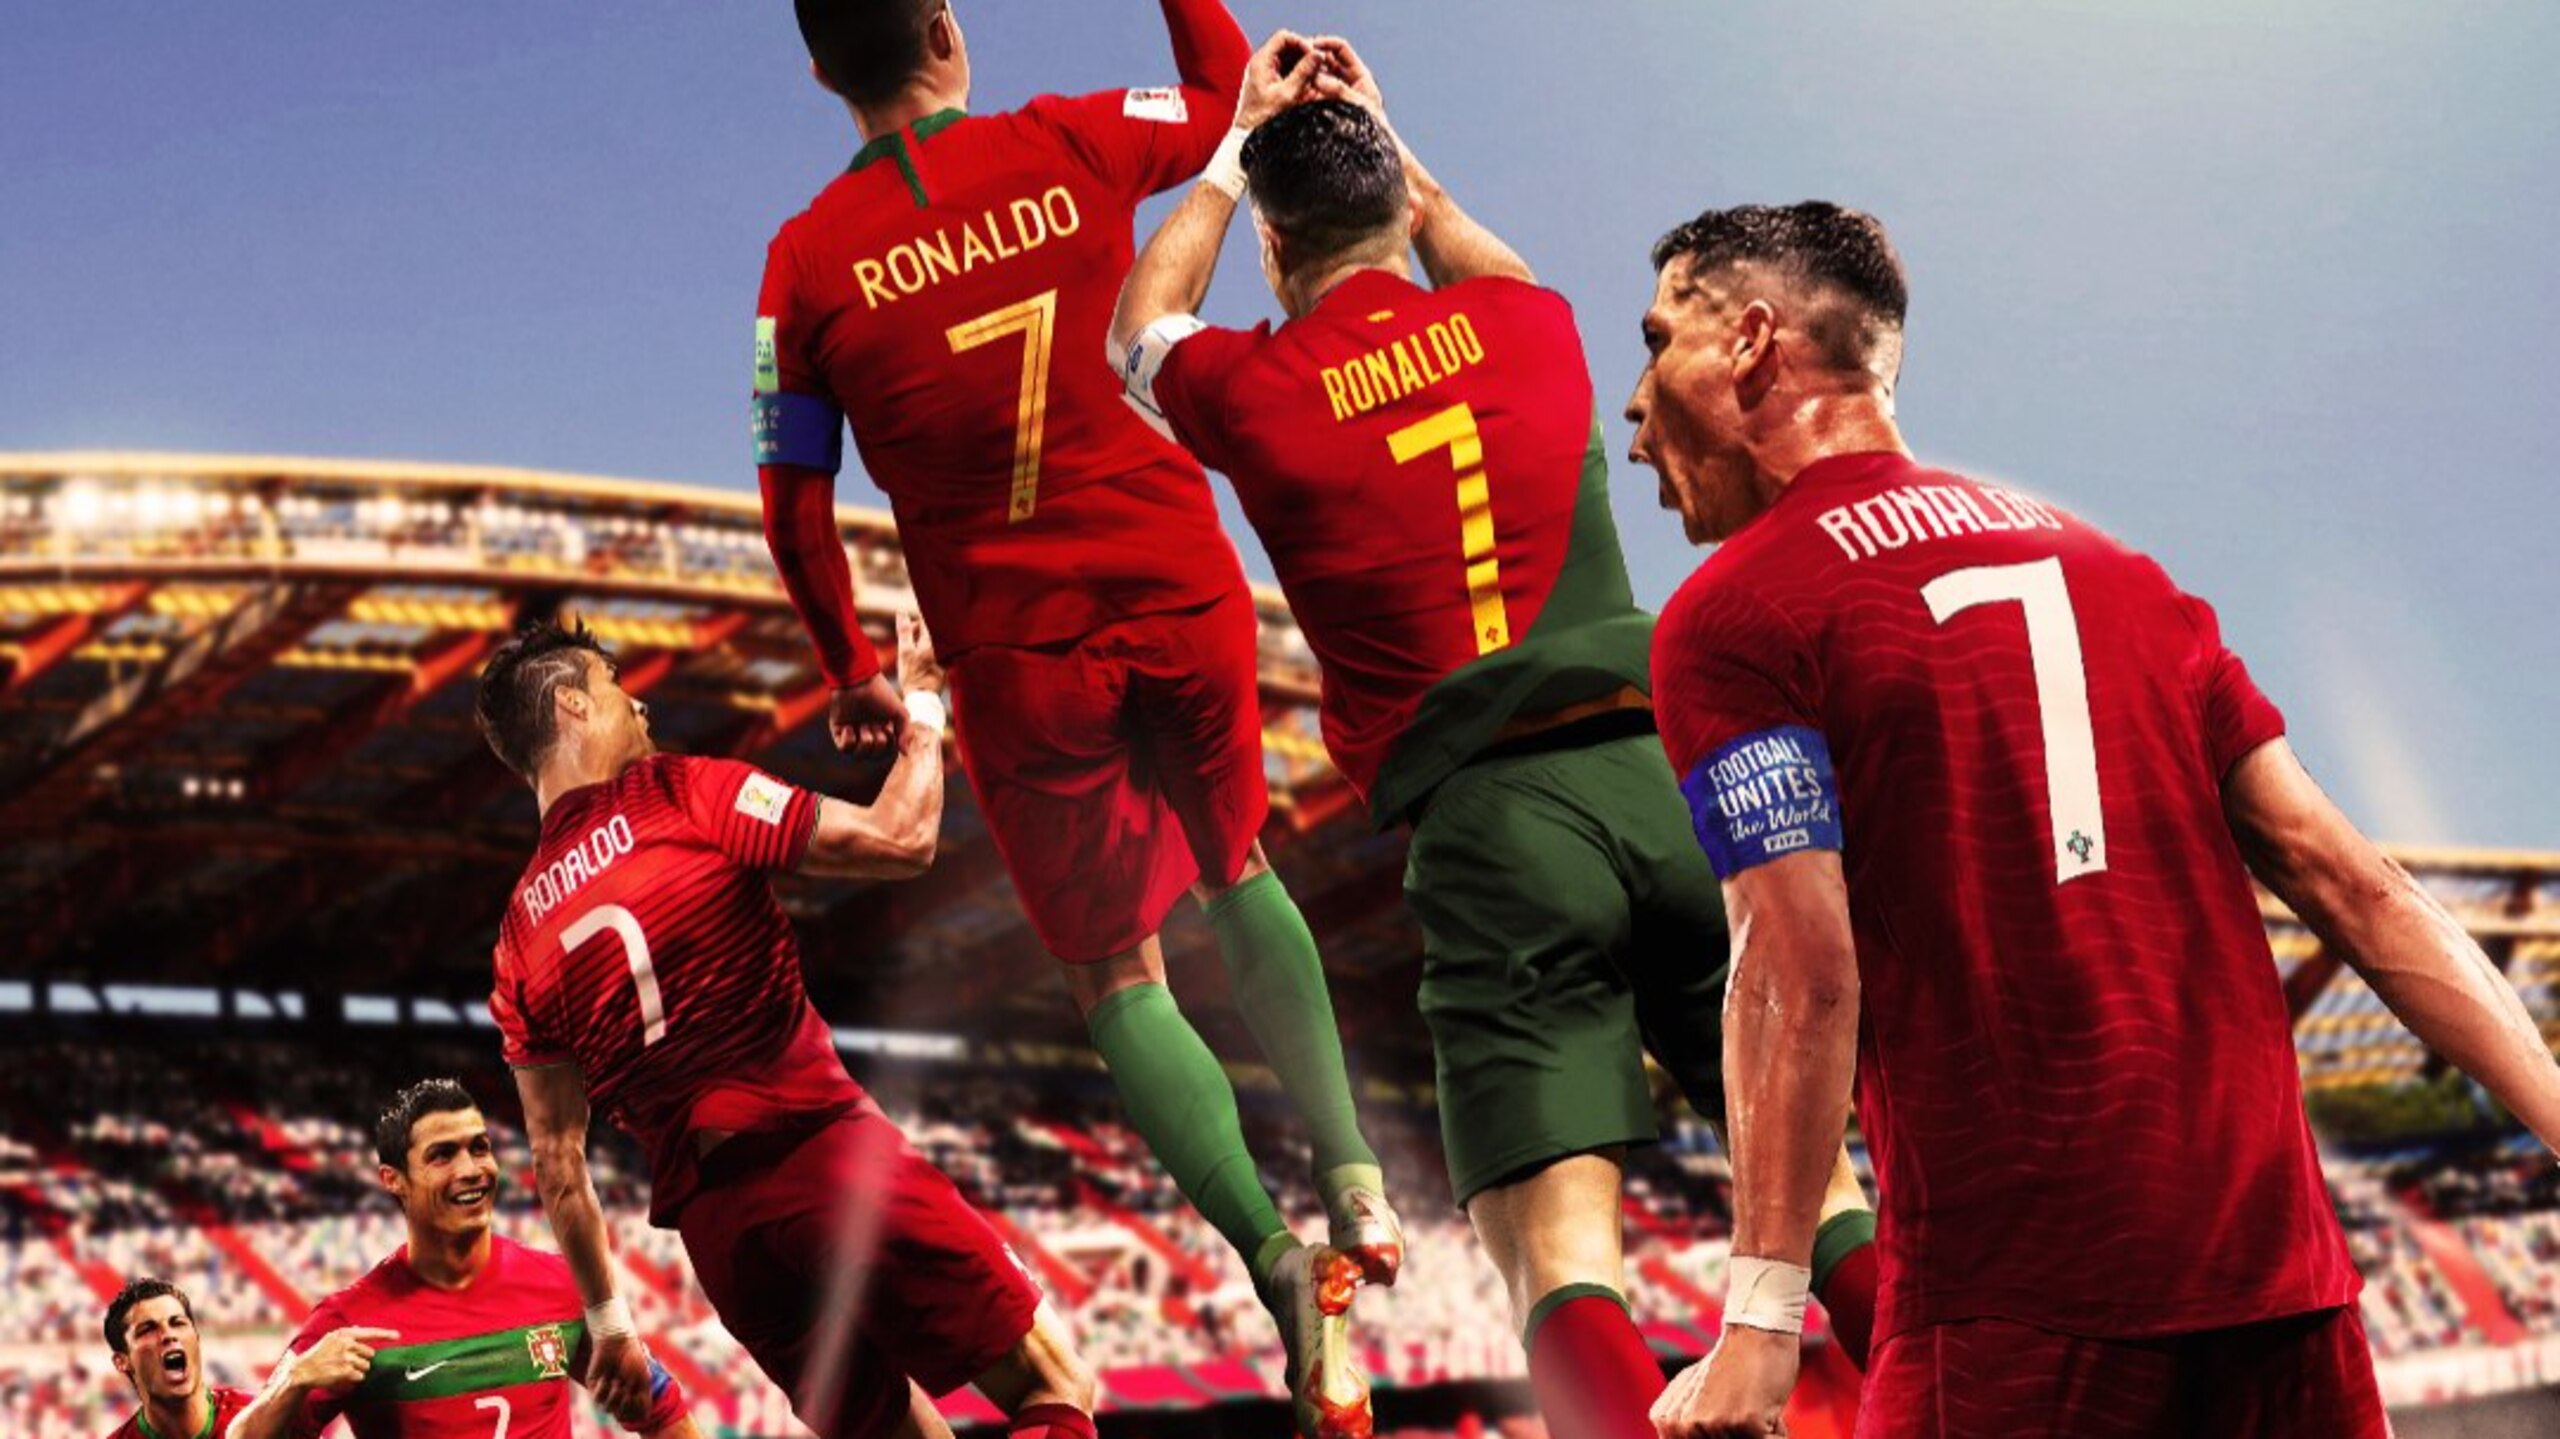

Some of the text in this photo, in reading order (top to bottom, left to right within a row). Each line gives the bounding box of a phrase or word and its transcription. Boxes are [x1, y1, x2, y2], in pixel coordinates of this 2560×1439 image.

[853, 186, 1080, 309] RONALDO
[945, 289, 1058, 524] 7
[1321, 313, 1485, 421] RONALDO
[1386, 402, 1509, 656] 7
[1815, 484, 2063, 562] RONALDO
[1708, 736, 1811, 792] FOOTBALL
[1919, 555, 2107, 885] 7
[1718, 766, 1822, 817] UNITES
[1730, 800, 1831, 842] the World
[523, 814, 634, 927] RONALDO
[559, 904, 666, 1047] 7
[474, 1396, 511, 1439] 7
